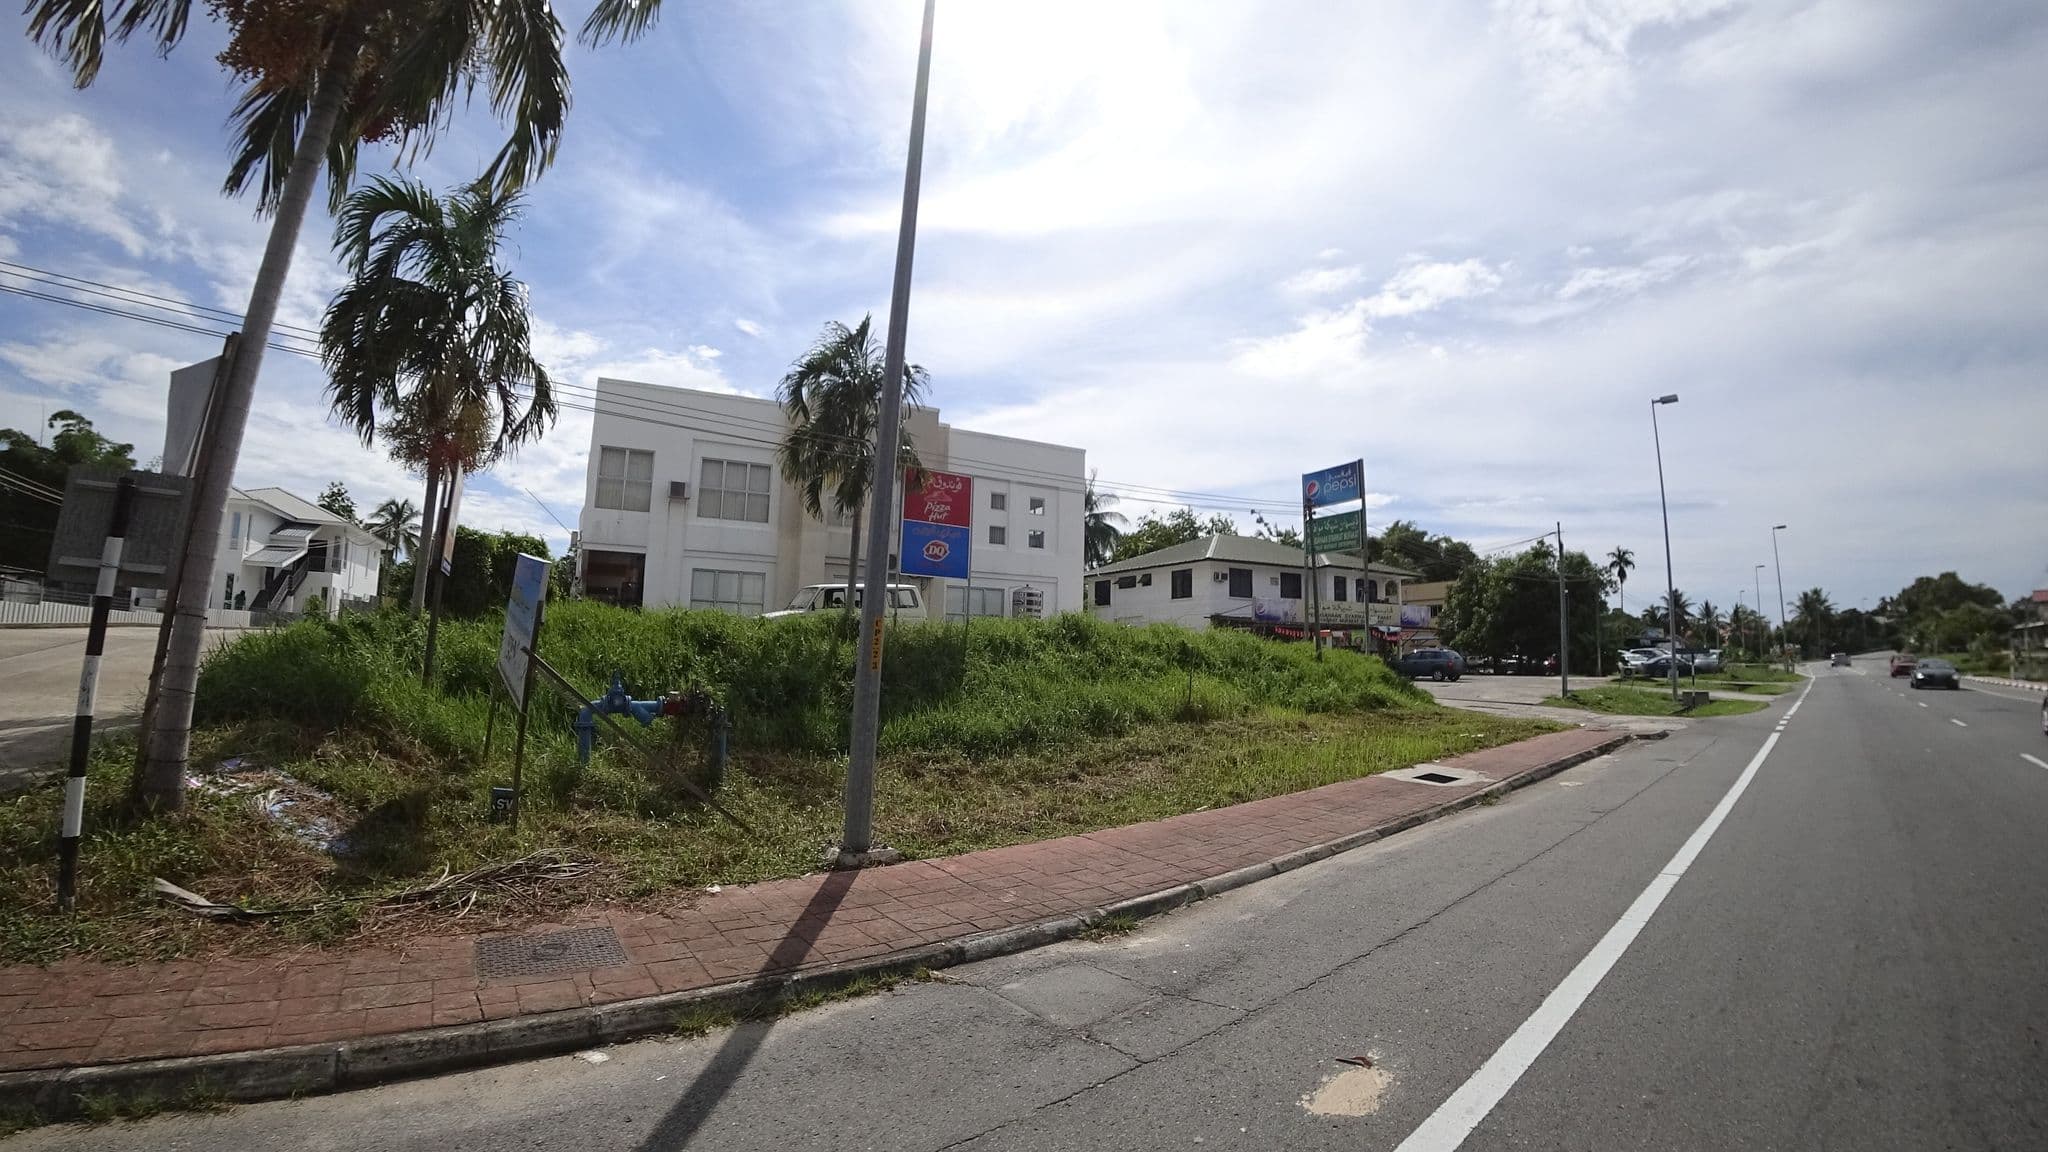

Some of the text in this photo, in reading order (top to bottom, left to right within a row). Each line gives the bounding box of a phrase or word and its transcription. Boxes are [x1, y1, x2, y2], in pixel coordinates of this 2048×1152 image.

[1323, 473, 1357, 497] pepsi
[924, 501, 952, 514] Pizza
[928, 511, 949, 522] Hut
[928, 545, 945, 557] DQ
